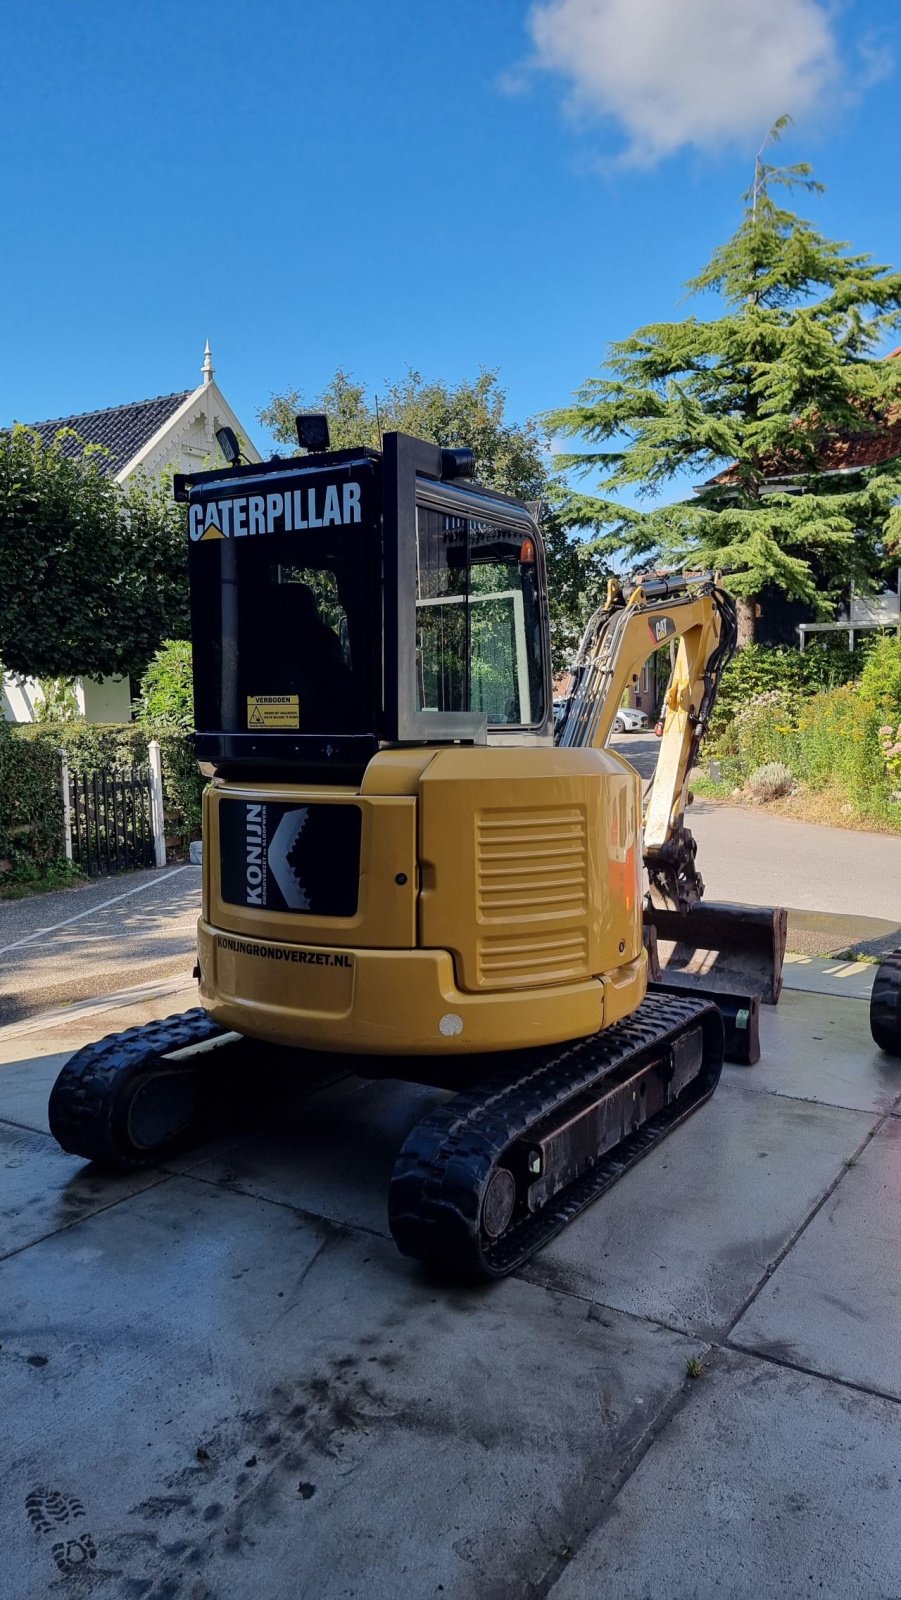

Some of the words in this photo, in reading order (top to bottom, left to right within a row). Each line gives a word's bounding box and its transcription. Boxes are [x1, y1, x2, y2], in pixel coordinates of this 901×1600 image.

[189, 482, 361, 541] CATERPILLAR
[655, 618, 667, 641] CAT
[246, 803, 262, 905] KONIJN
[217, 936, 353, 968] KONIJNGRONDVERZET.NL
